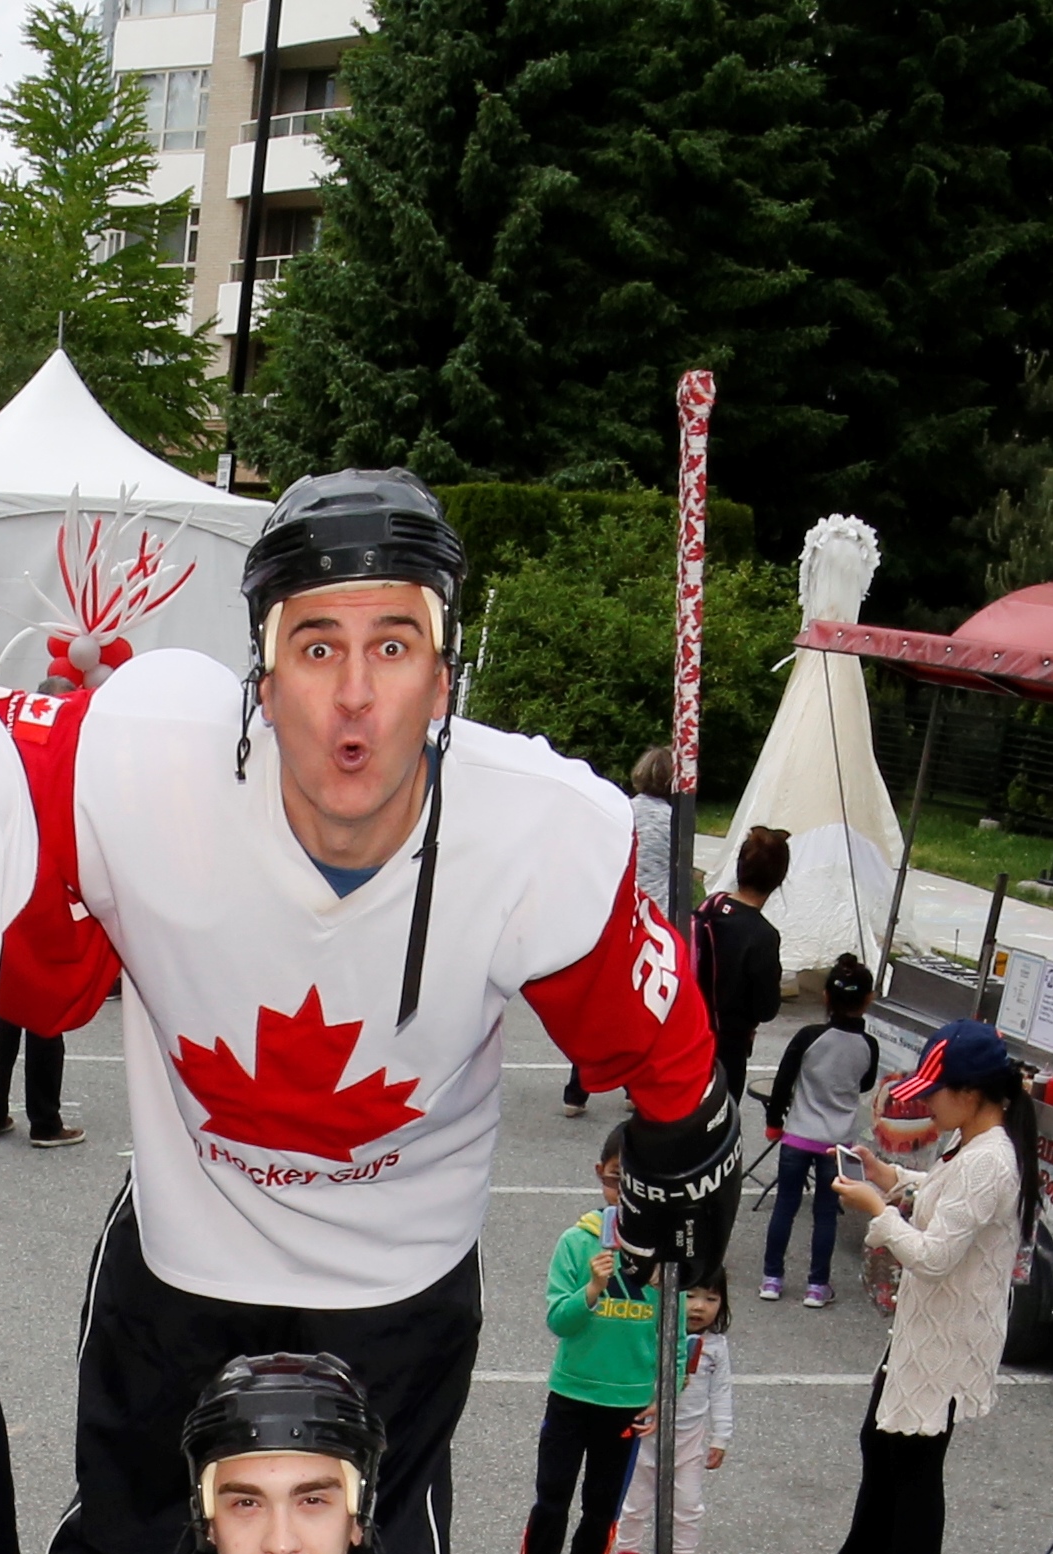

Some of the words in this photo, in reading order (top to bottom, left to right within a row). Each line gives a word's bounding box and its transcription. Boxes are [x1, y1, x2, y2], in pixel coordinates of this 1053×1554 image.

[210, 1143, 319, 1187] Hockey
[327, 1148, 400, 1184] Guys
[595, 1298, 654, 1318] didas
